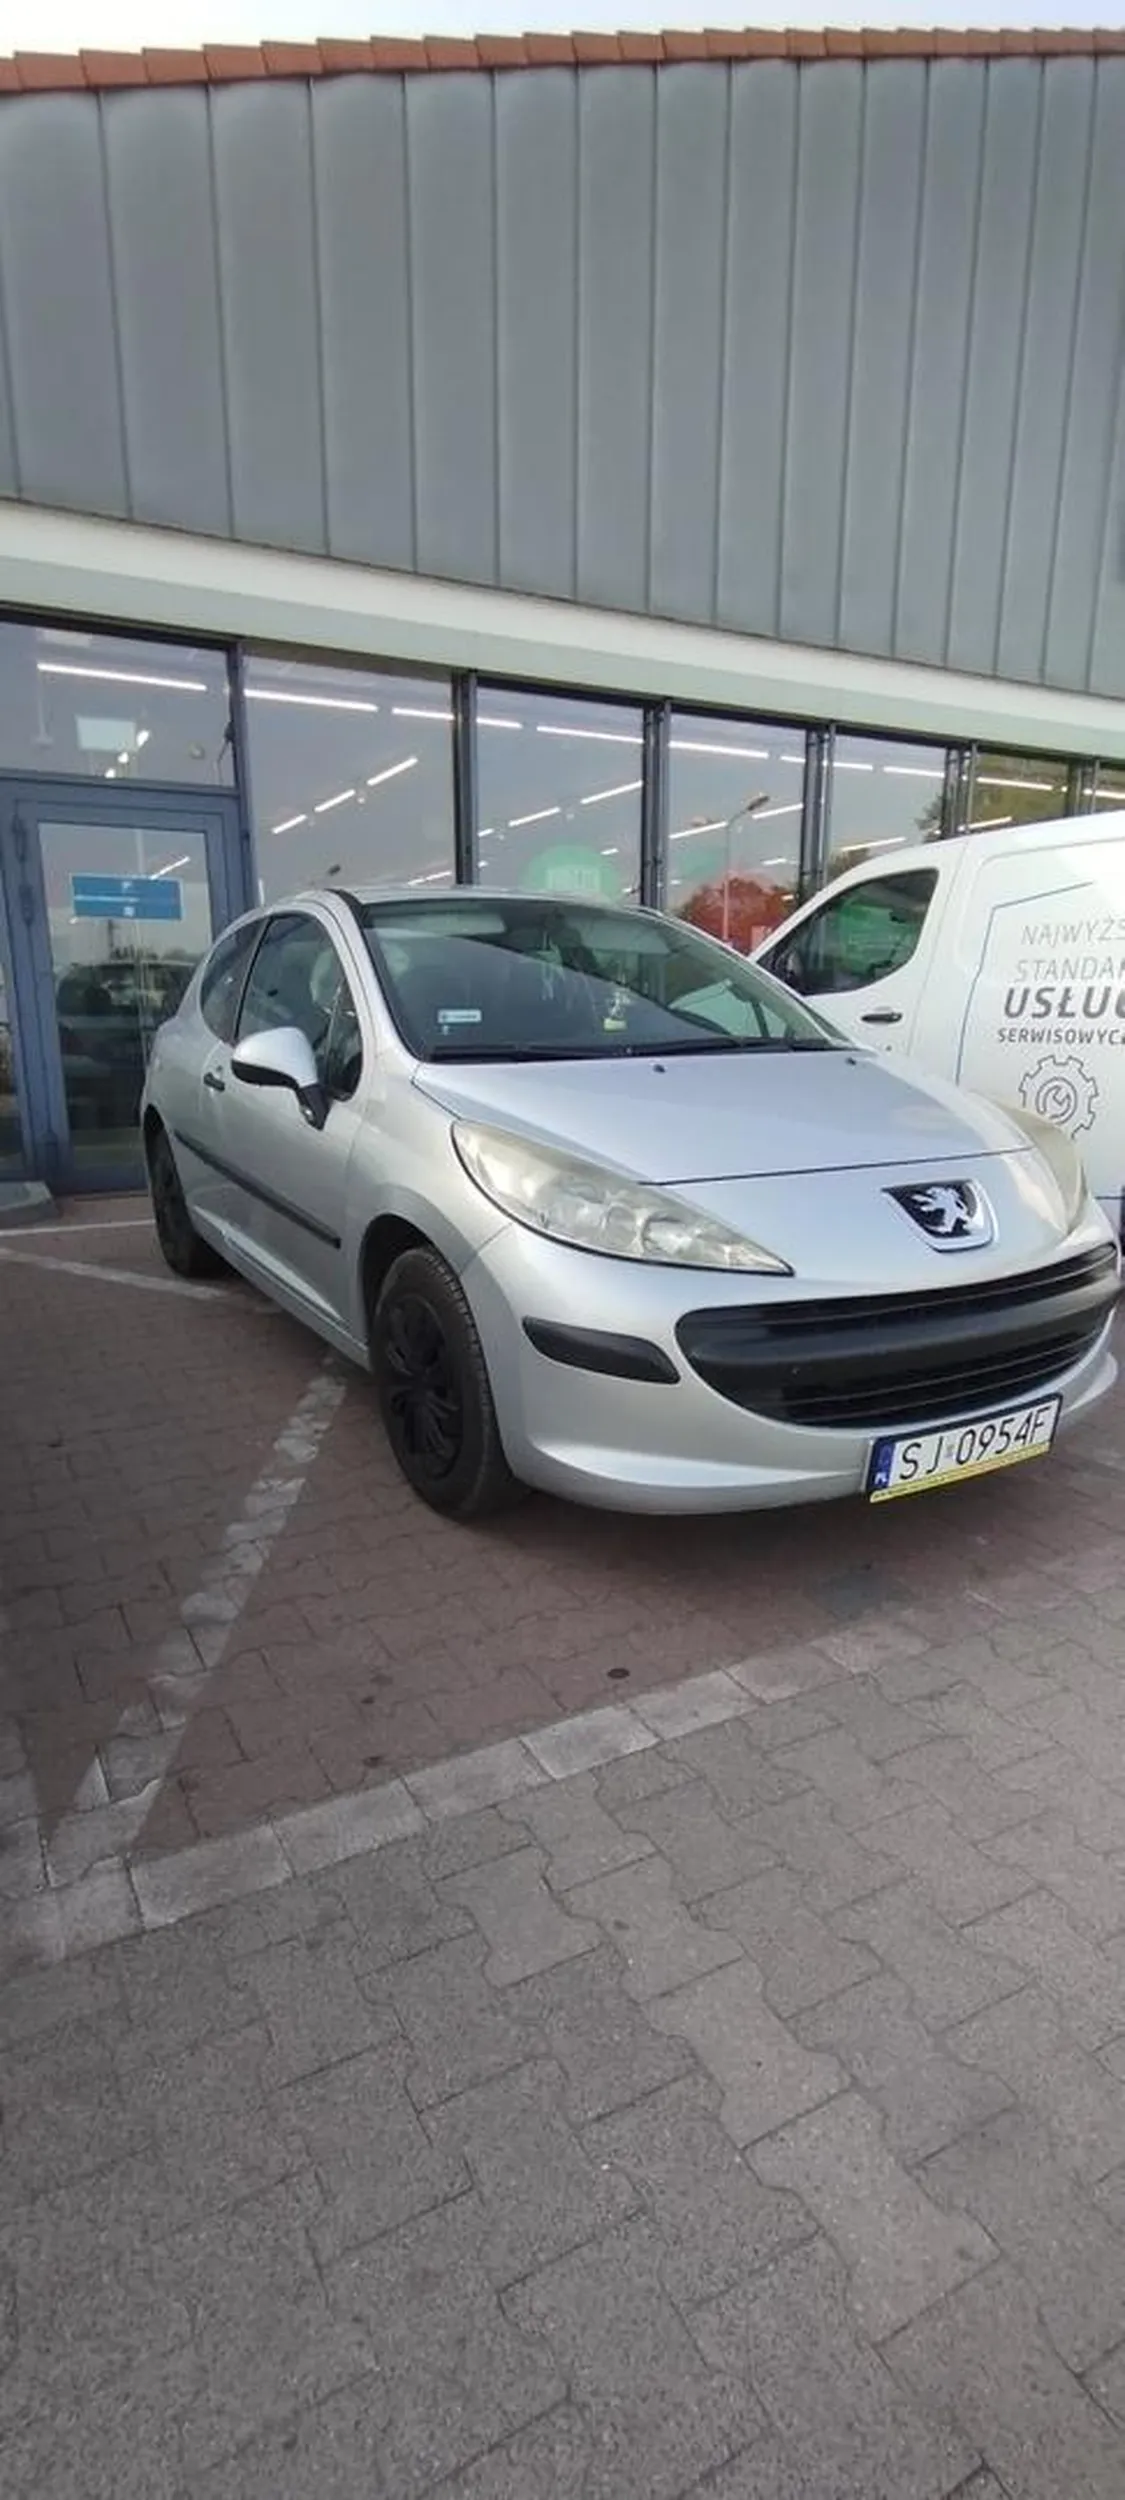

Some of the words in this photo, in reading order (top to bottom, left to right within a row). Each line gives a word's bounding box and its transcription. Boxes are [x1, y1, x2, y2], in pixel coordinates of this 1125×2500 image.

[998, 1027, 1125, 1045] SERWISOWYC
[900, 1435, 945, 1480] SJ
[956, 1406, 1050, 1467] 0954F
